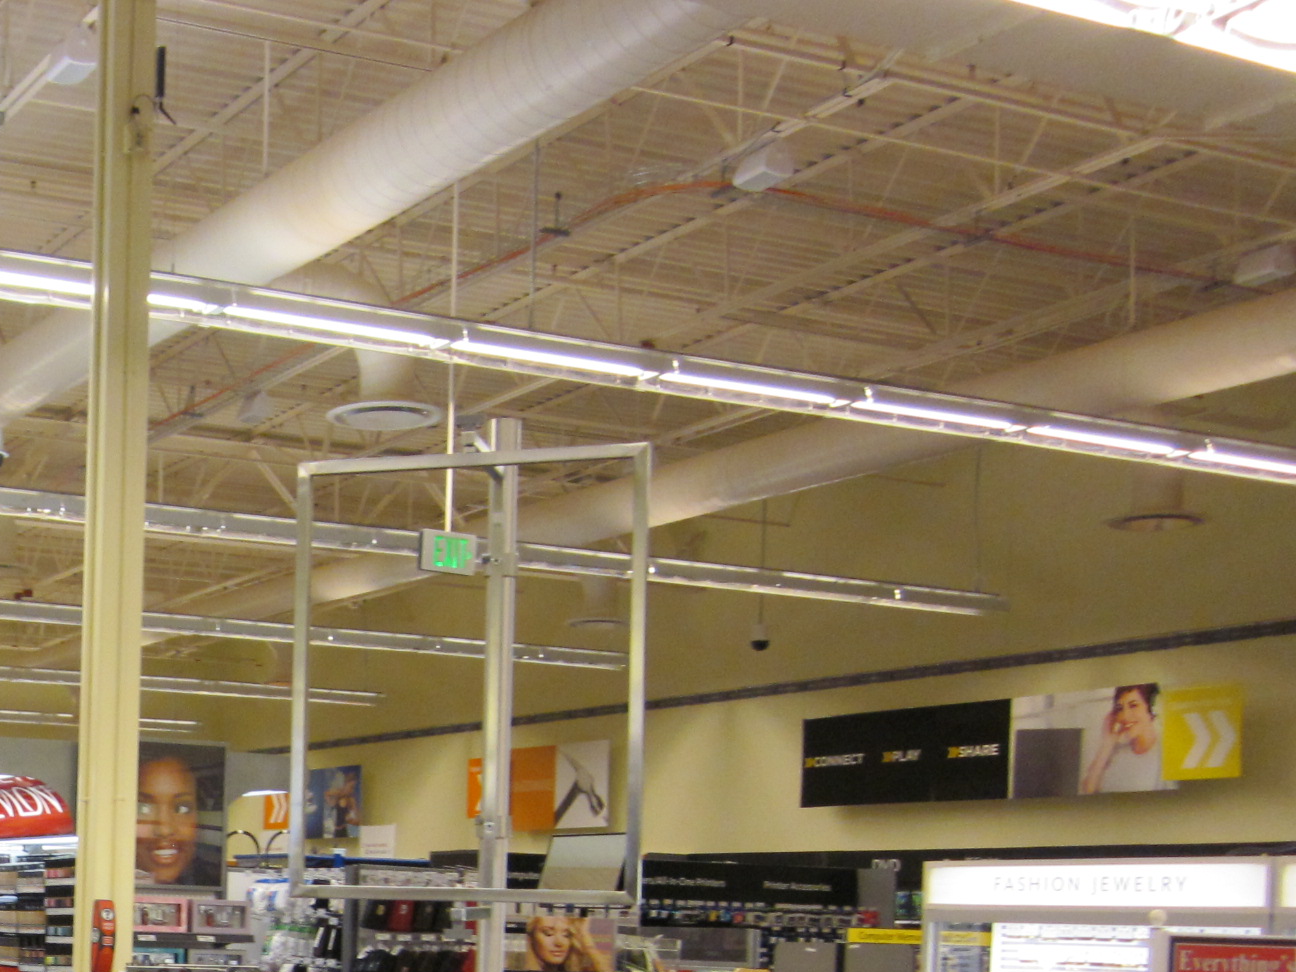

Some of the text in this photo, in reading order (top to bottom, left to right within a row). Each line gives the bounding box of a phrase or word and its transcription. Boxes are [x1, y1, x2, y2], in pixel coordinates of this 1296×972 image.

[433, 535, 469, 569] EXIT
[814, 744, 1000, 768] CONNECT PLAY SHARE
[993, 876, 1188, 895] FASHION JEWELRY
